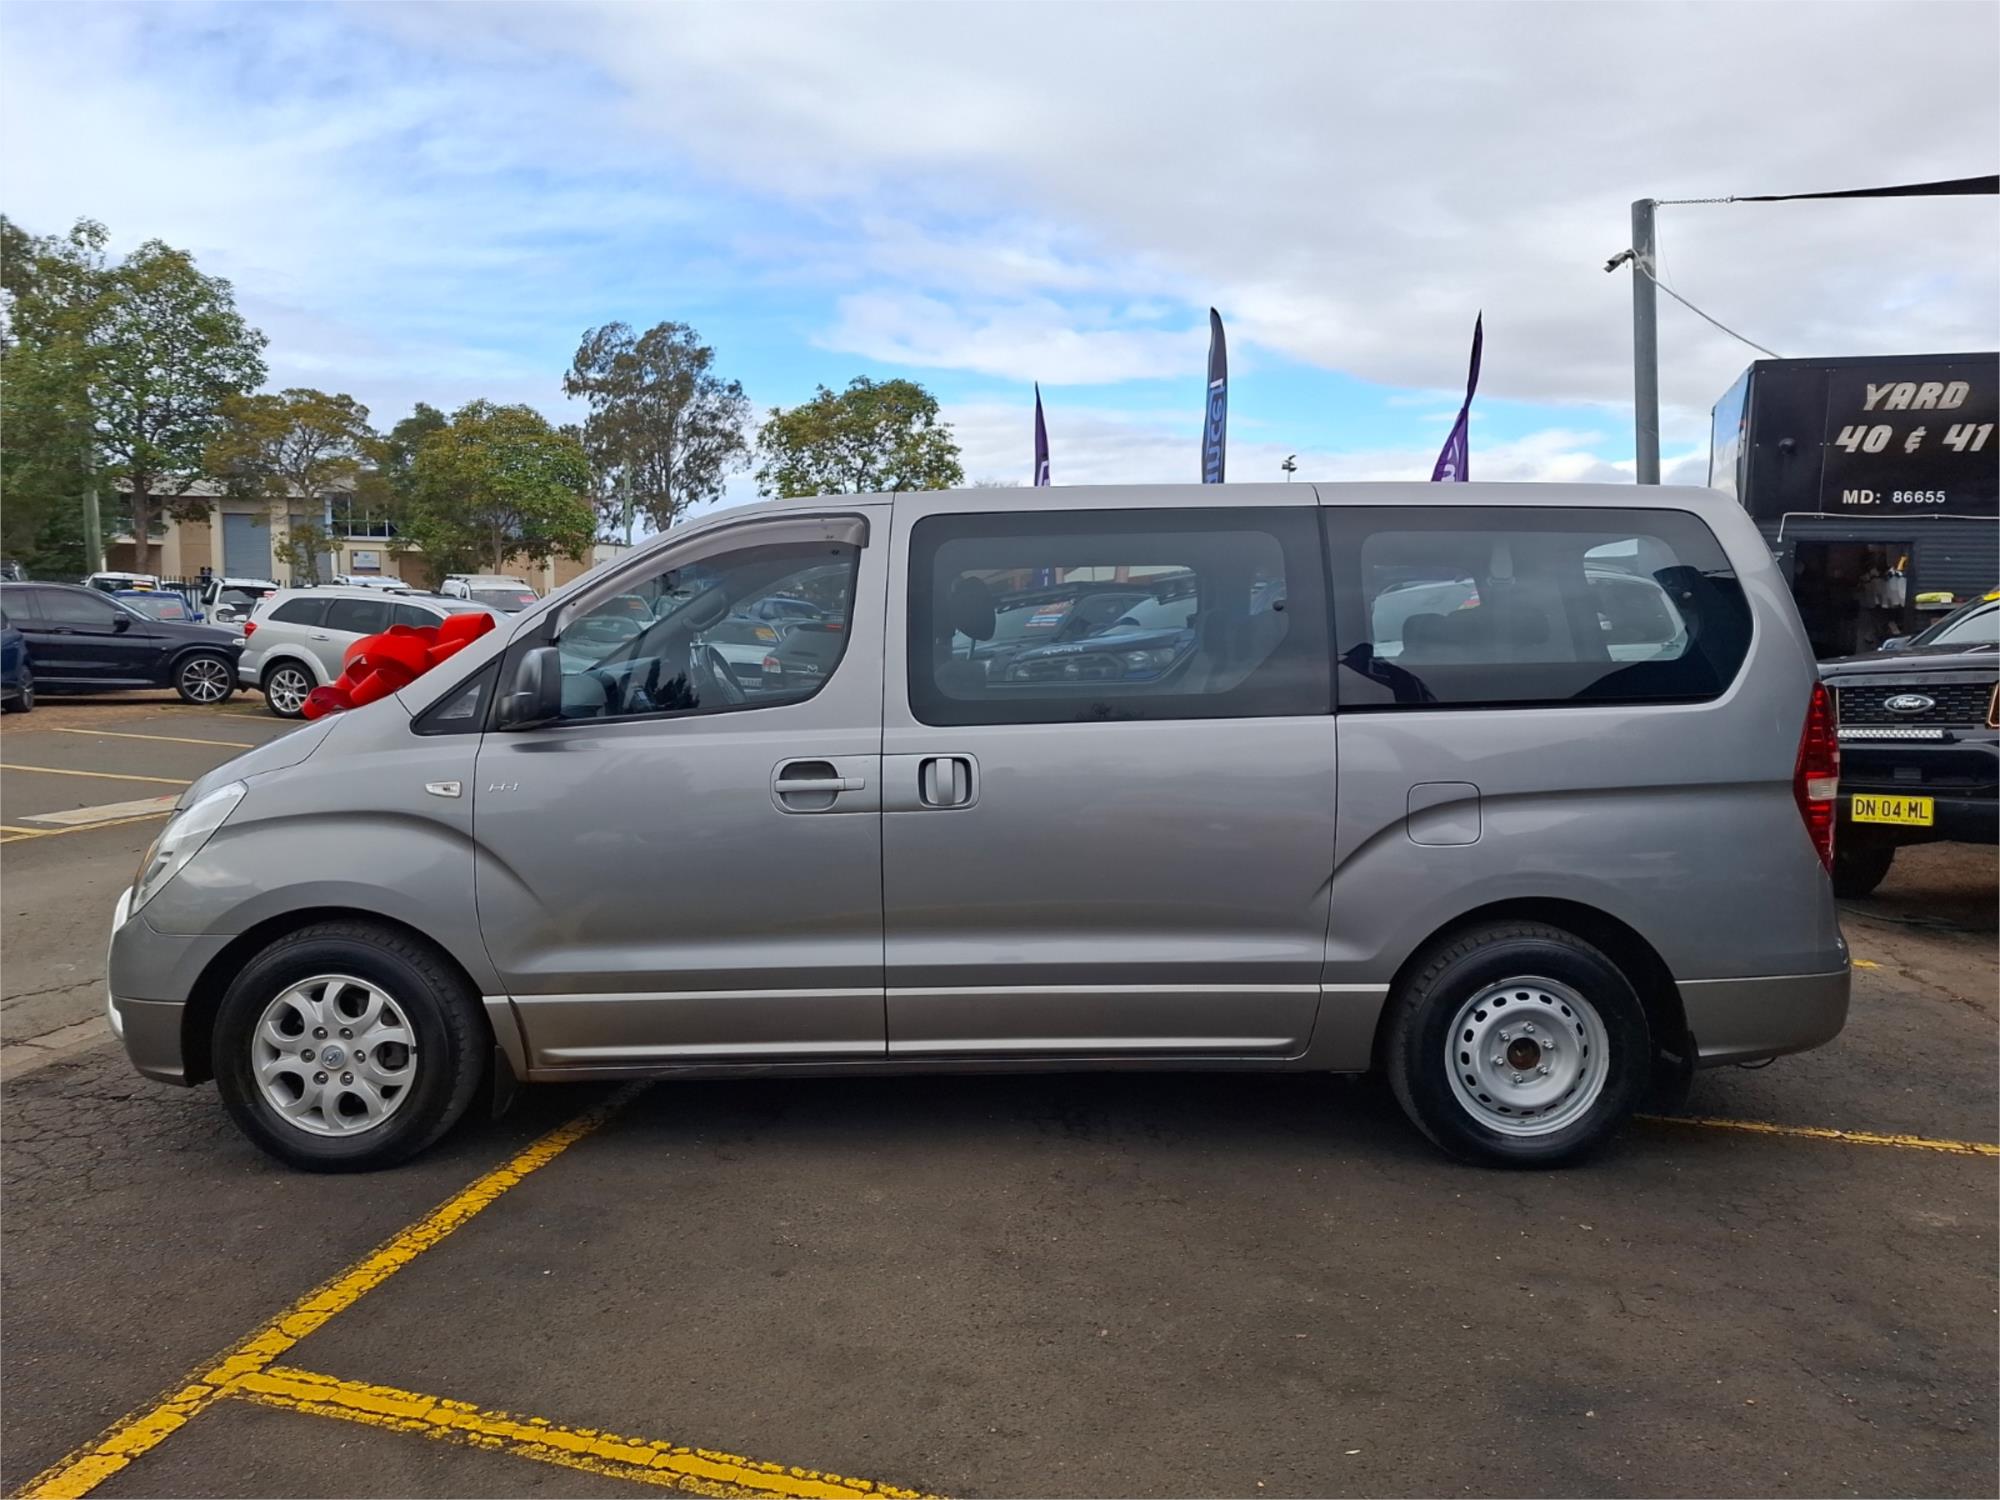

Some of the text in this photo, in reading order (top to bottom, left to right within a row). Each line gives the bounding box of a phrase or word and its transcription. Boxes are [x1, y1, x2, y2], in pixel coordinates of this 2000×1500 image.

[1863, 381, 1970, 411] YARD
[1835, 423, 1995, 453] 40 & 41
[1842, 490, 1946, 504] MD: 86655
